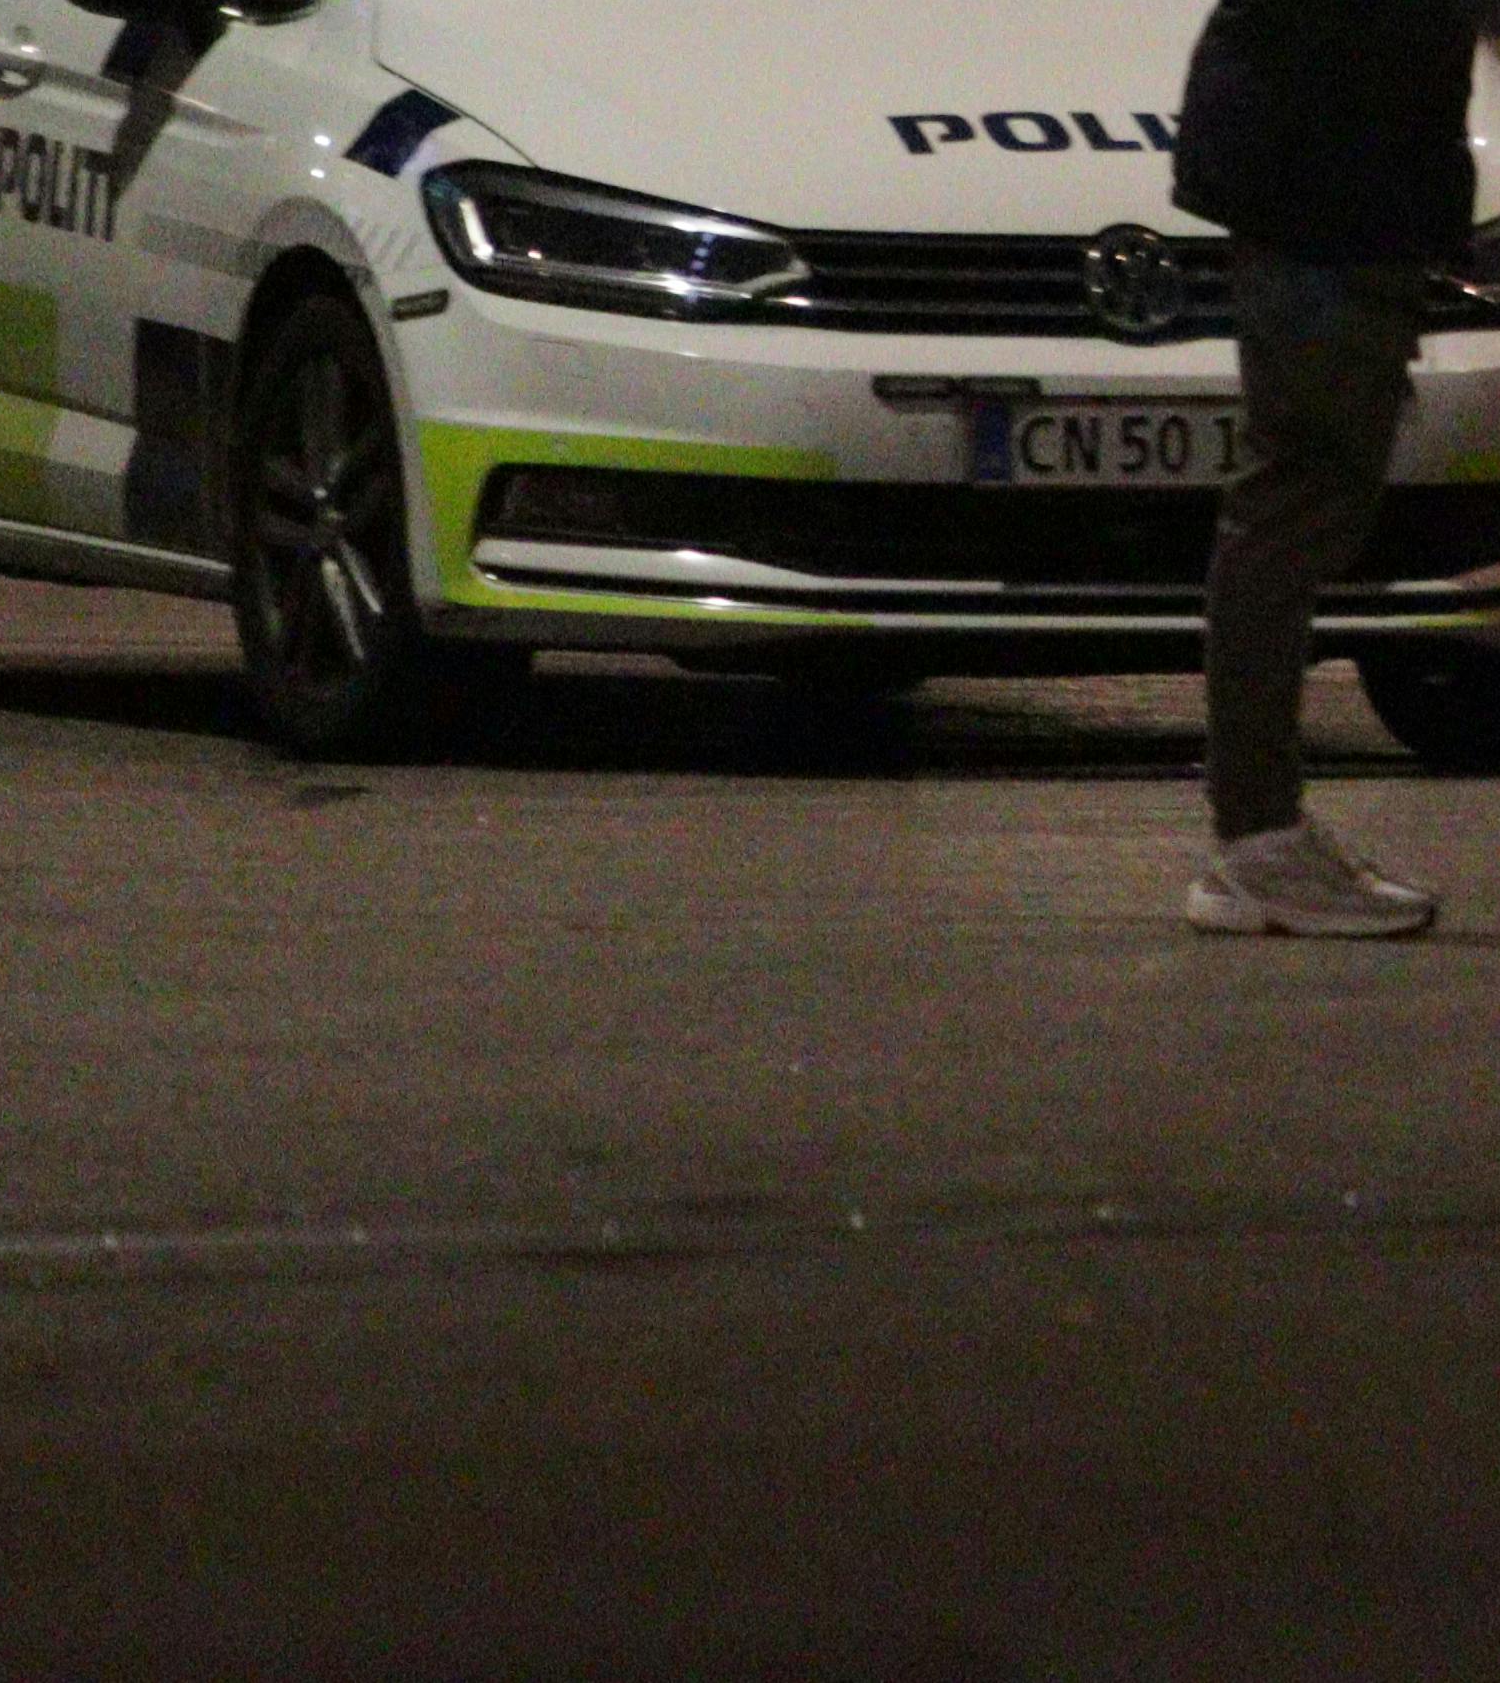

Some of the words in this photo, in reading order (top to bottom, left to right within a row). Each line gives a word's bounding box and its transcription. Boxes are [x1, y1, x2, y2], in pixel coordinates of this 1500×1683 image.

[888, 112, 1180, 154] POLI
[1021, 415, 1098, 473] CN
[1119, 415, 1189, 473] 50
[1213, 415, 1242, 473] 1
